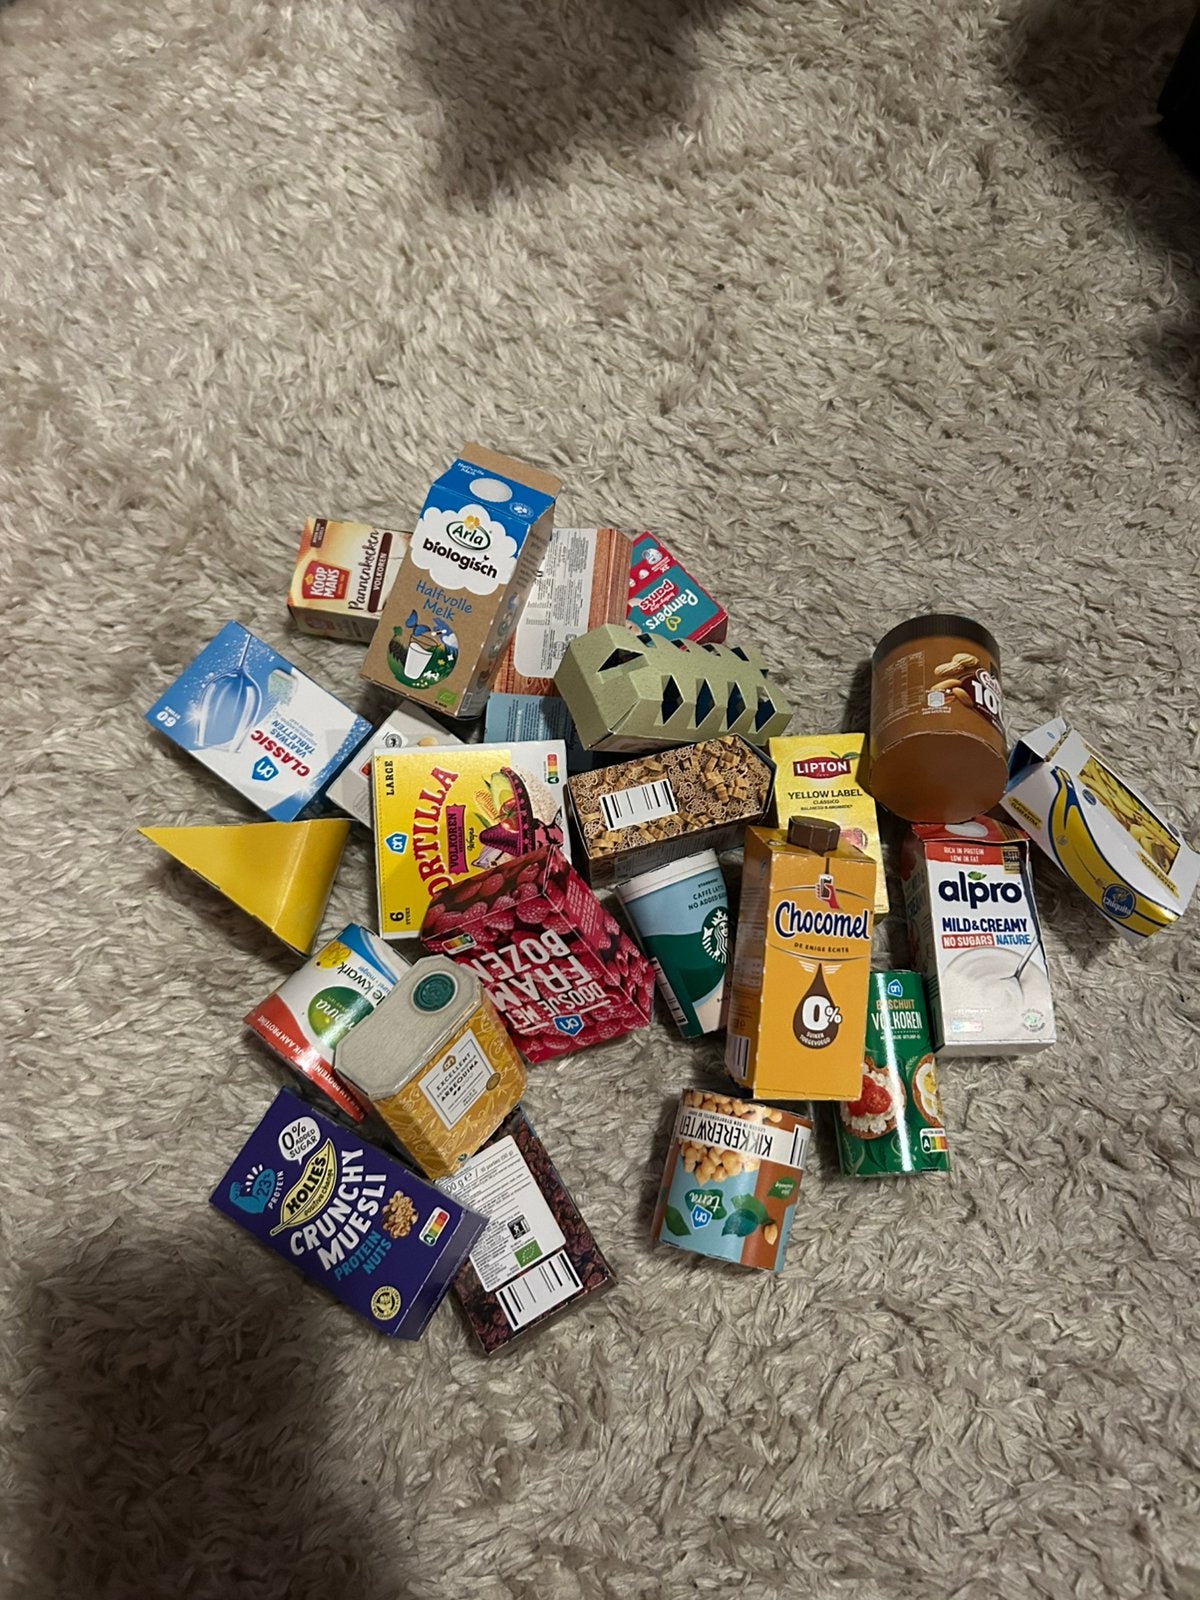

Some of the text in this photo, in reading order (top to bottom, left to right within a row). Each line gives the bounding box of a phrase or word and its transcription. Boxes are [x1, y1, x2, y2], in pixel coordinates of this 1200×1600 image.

[452, 525, 483, 545] Arla
[348, 530, 379, 610] Pannenkoeken
[373, 553, 387, 590] VOLKOREN
[423, 538, 497, 578] biologisch
[310, 567, 327, 596] KOOP
[324, 569, 339, 598] MANS
[416, 580, 473, 615] Halfvolle
[639, 579, 675, 615] pants
[422, 599, 456, 622] Melk
[646, 588, 698, 631] Pampers
[156, 711, 177, 728] 60
[251, 729, 311, 778] CLASSIC
[270, 728, 308, 758] VAATWAS
[271, 720, 316, 755] TABLETTEN
[386, 760, 394, 796] LARGE
[796, 761, 848, 774] LIPTON
[788, 788, 863, 800] YELLOW LABEL
[412, 767, 460, 900] ORTILLA
[450, 812, 459, 868] VOLKOREN
[943, 847, 955, 855] RICH
[957, 847, 962, 855] IN
[687, 902, 698, 910] NO
[698, 894, 719, 906] ADDED
[938, 871, 1022, 909] alpro
[390, 911, 404, 922] 6
[774, 901, 870, 940] Chocomel
[806, 944, 825, 952] ENIGE
[943, 934, 1031, 947] NO SUGARS NATURE
[336, 961, 375, 994] kwark
[487, 956, 592, 1011] FRAM
[505, 981, 607, 1030] DOOSJE MET
[802, 996, 842, 1031] 0%
[871, 1012, 922, 1030] VOLKOREN
[876, 999, 914, 1010] BSCHUIT
[279, 1031, 296, 1048] AAN
[799, 1035, 831, 1046] TOEGEVOEGD
[806, 1031, 824, 1039] SUIKER
[436, 1051, 472, 1091] EXCELLENT
[441, 1060, 480, 1101] ARBEQUINA
[281, 1121, 307, 1149] 0%
[289, 1135, 318, 1159] SUGAR
[295, 1128, 316, 1146] ADDED
[680, 1115, 773, 1157] KIKKERERWTEN
[267, 1170, 284, 1210] PROTEIN
[285, 1153, 328, 1214] HOLIE'S
[290, 1149, 365, 1256] CRUNCHY
[689, 1192, 722, 1212] terra
[316, 1174, 387, 1271] MUESLI
[334, 1230, 382, 1281] PROTEIN
[362, 1238, 392, 1275] NUTS
